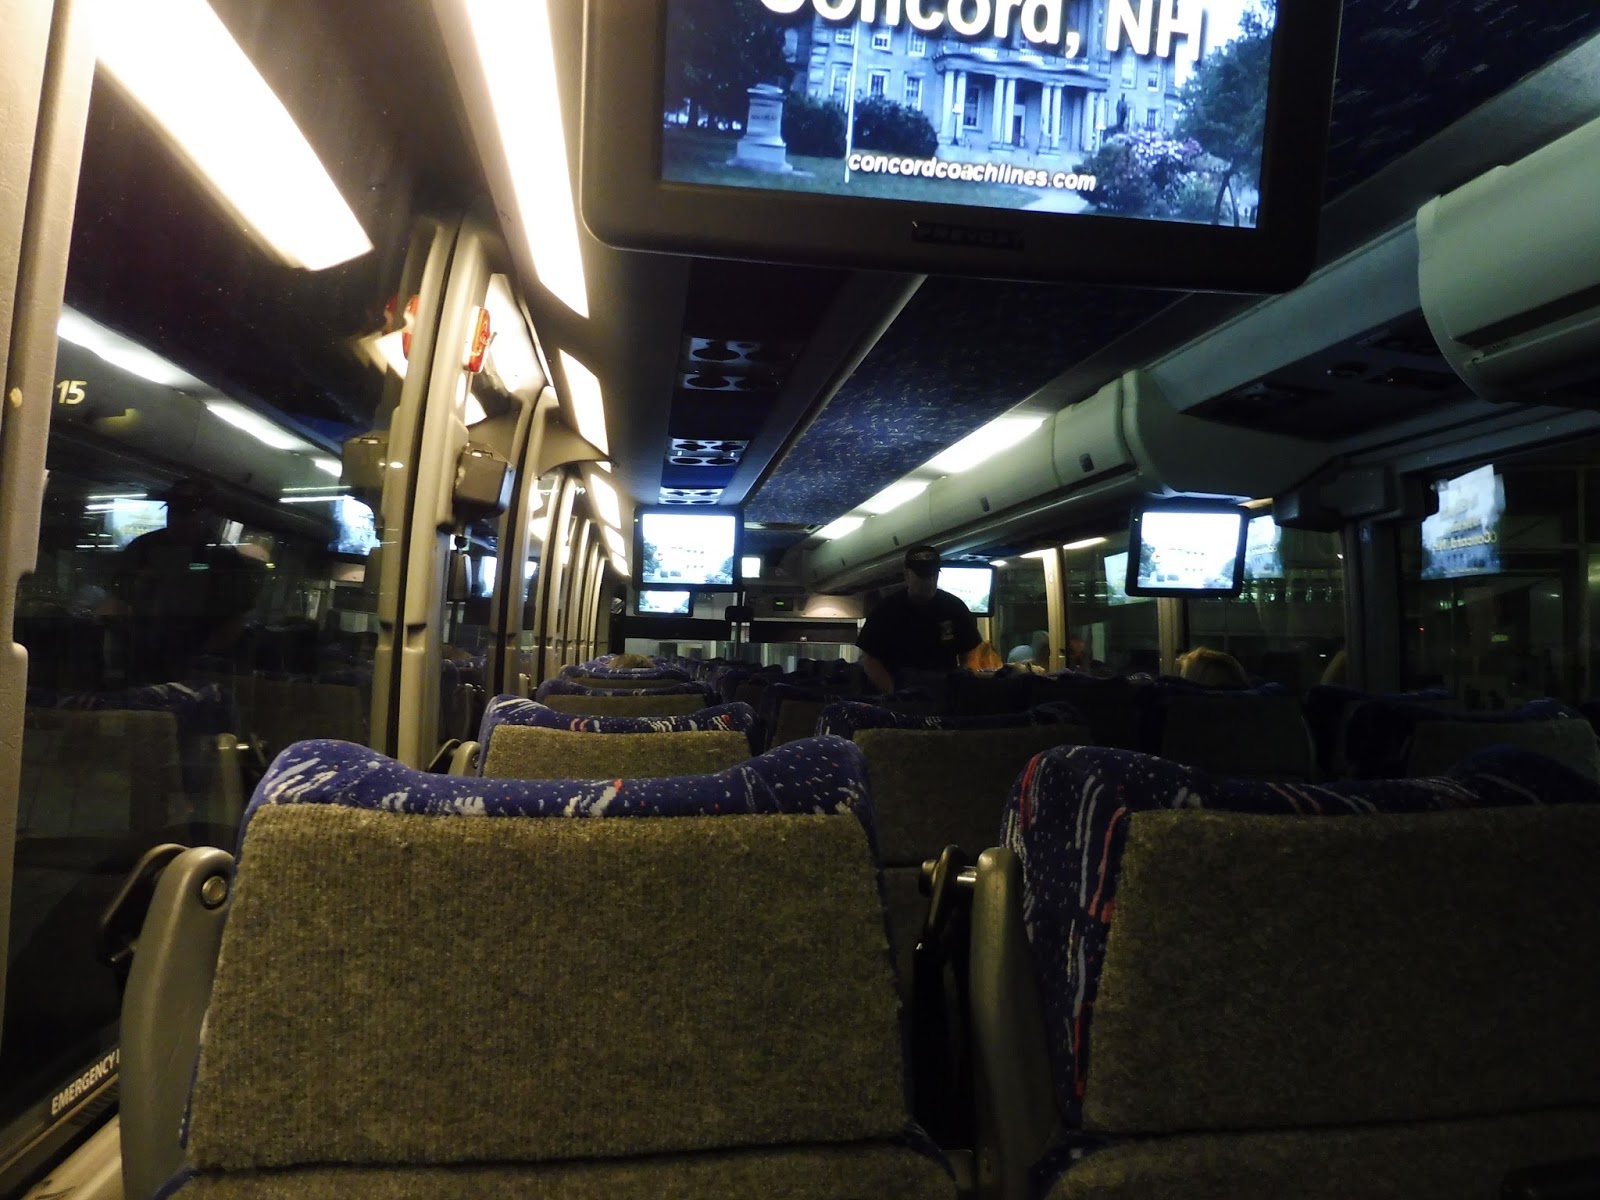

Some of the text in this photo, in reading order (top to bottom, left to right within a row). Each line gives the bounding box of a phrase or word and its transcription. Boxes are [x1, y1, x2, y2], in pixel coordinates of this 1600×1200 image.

[759, 0, 1202, 61] ncord, NH
[848, 153, 1097, 191] concordcoachlines.com
[56, 379, 88, 405] 15
[51, 1050, 116, 1116] EMERGENCY
